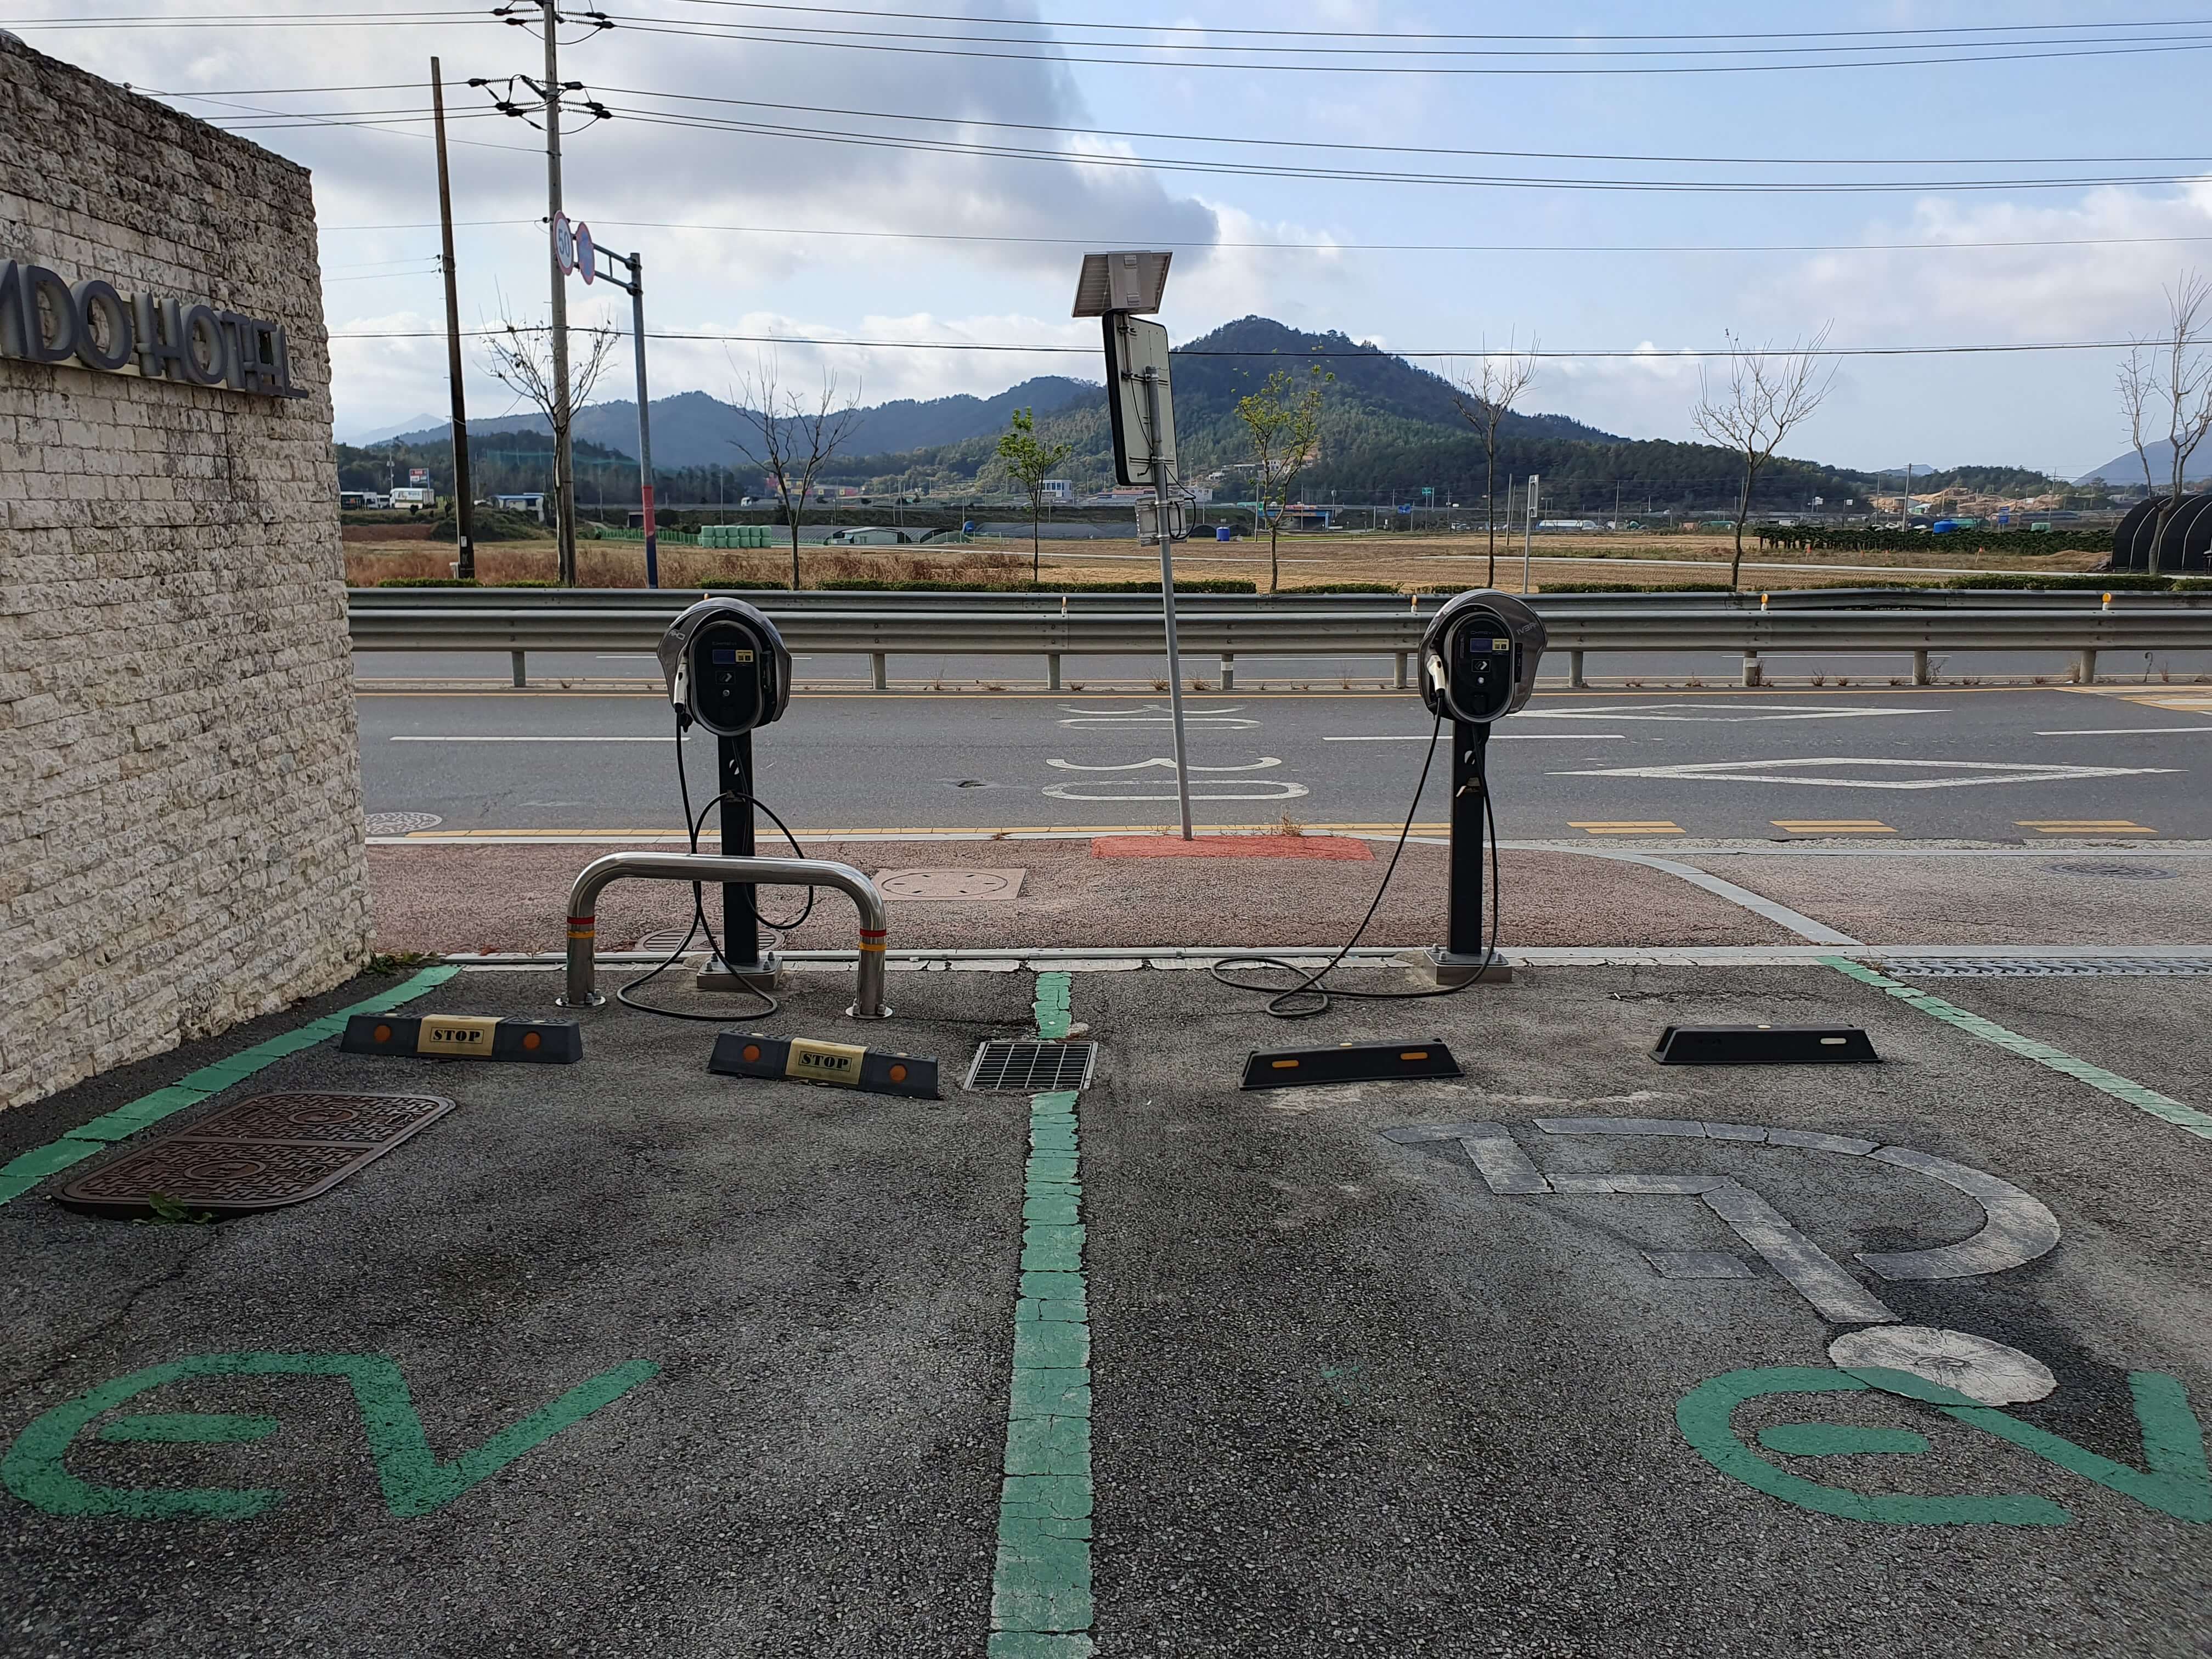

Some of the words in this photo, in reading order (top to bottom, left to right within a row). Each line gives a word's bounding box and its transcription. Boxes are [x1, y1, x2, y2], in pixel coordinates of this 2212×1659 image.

[558, 228, 571, 258] 50
[131, 292, 309, 398] HOTEL
[433, 1029, 480, 1041] STOP
[802, 1053, 848, 1068] STOP
[2, 1351, 662, 1519] EV
